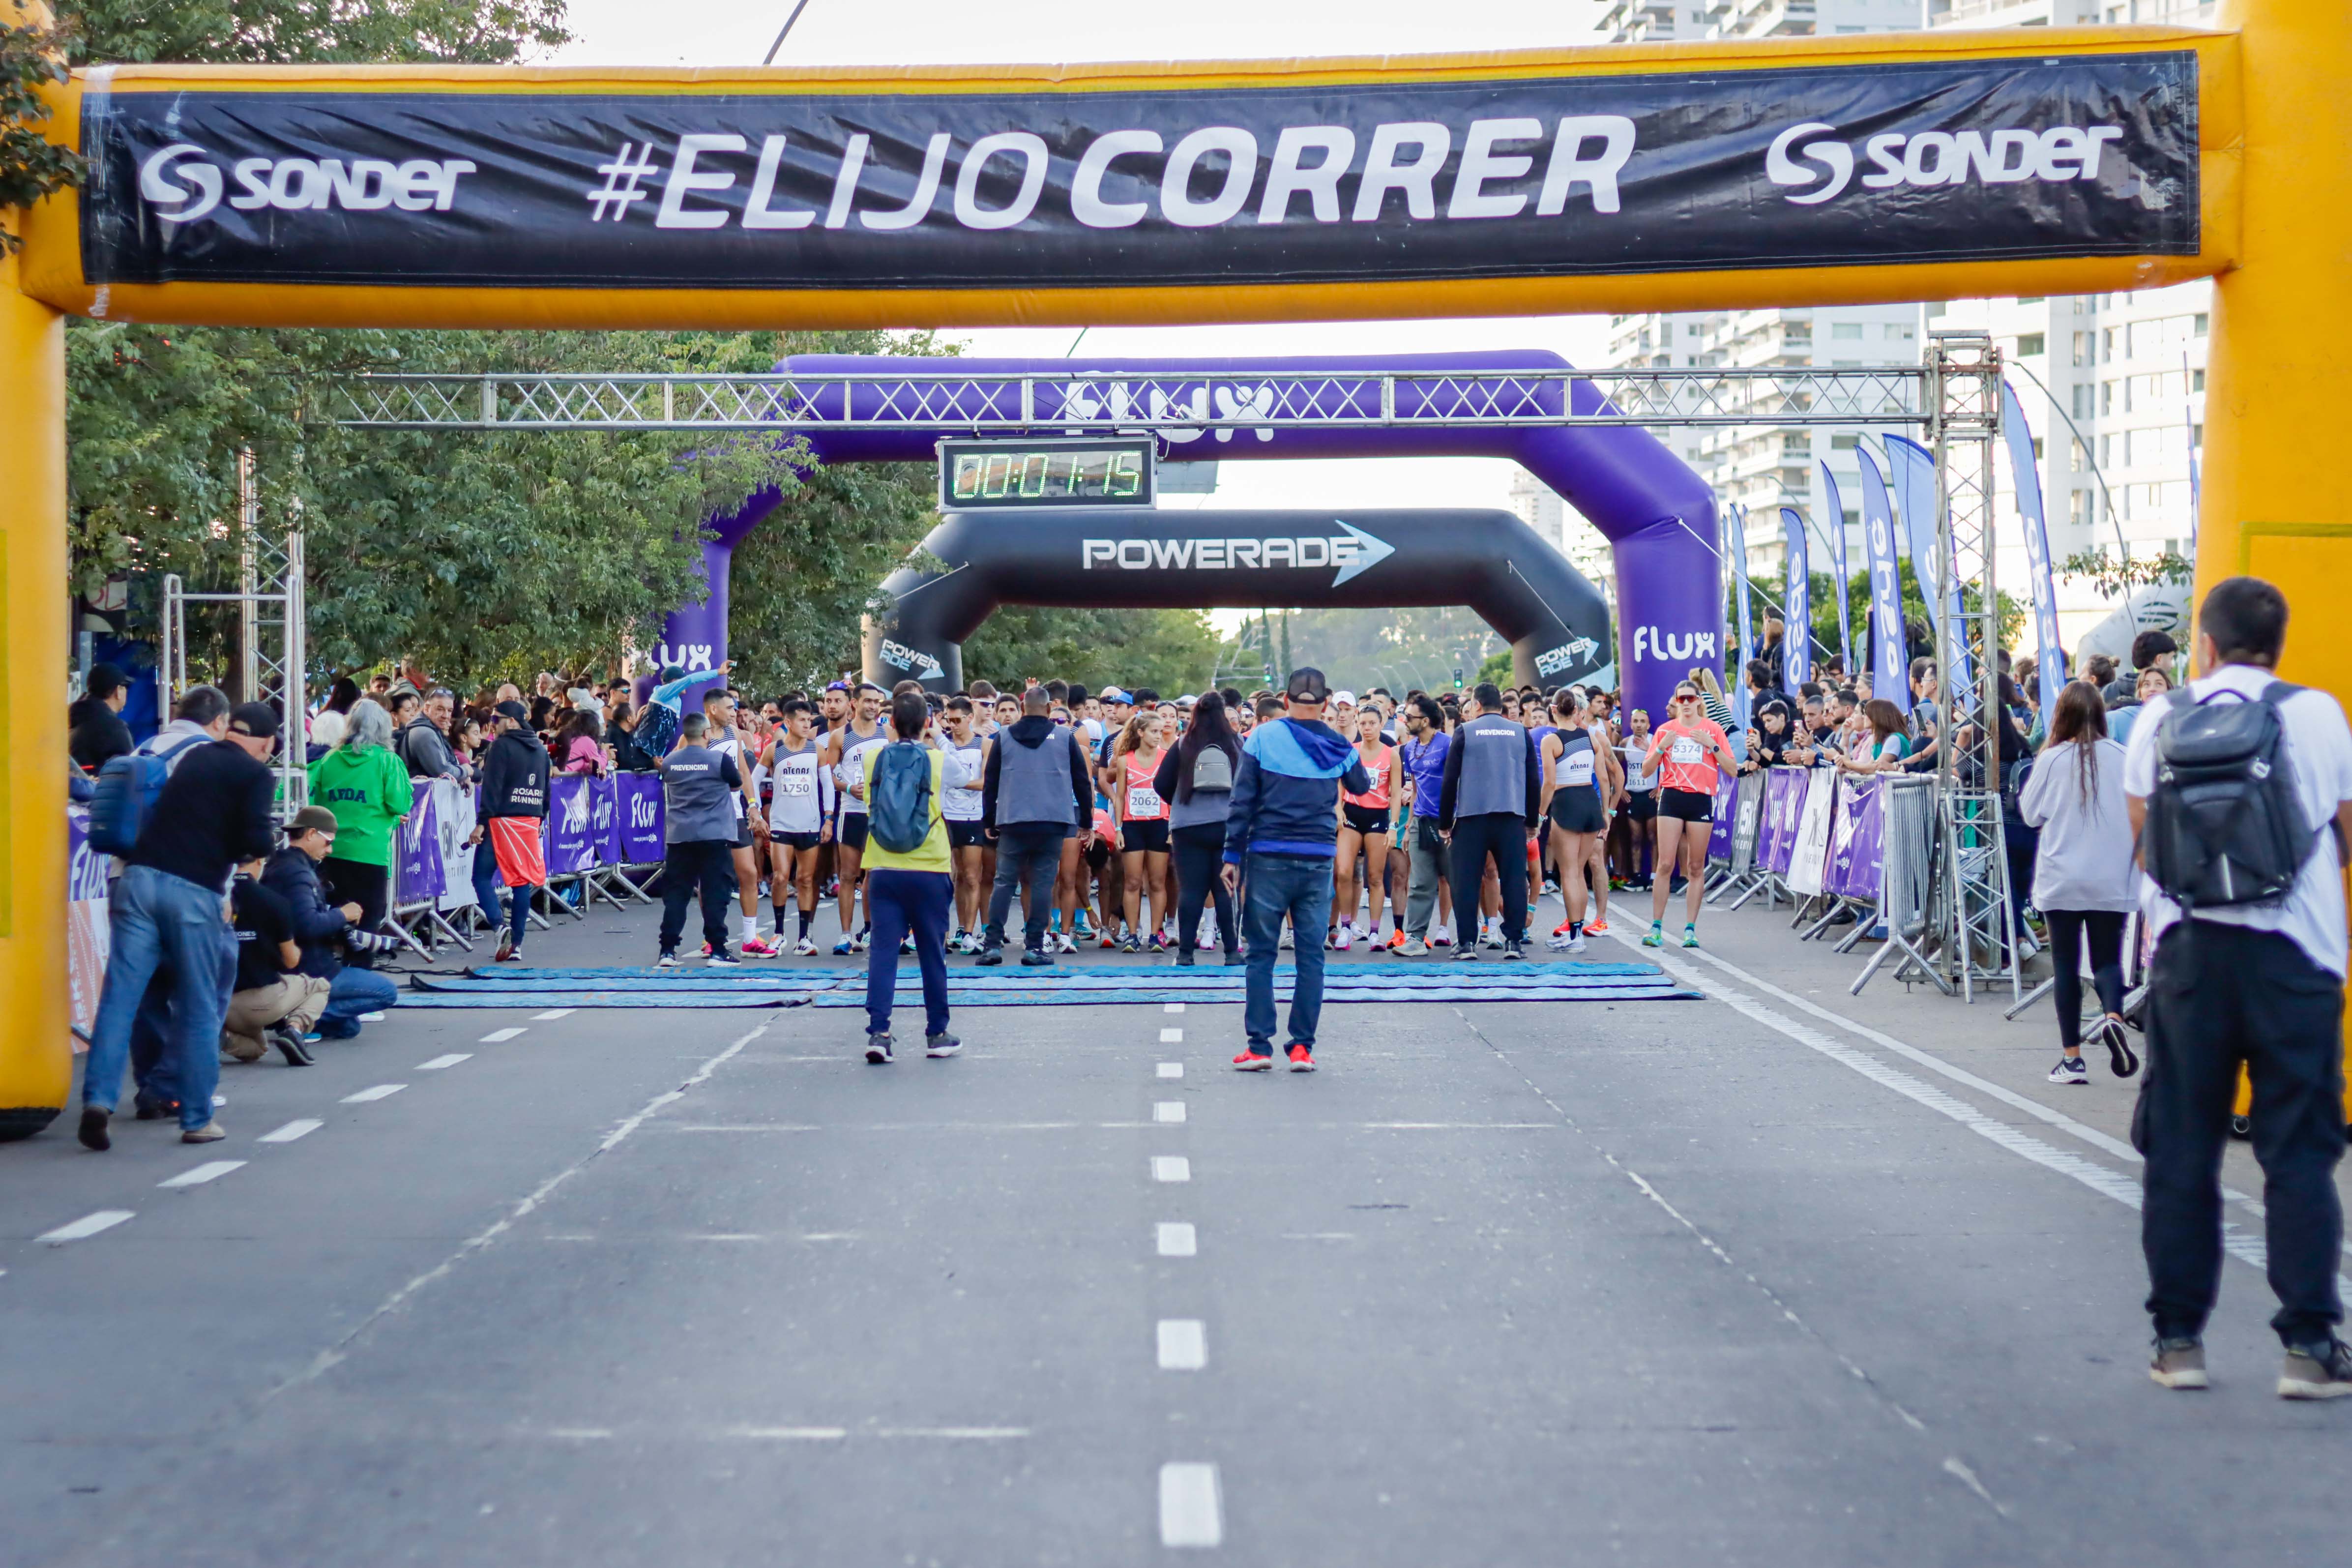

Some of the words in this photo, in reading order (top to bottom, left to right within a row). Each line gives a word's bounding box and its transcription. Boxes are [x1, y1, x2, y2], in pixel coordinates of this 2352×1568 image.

[953, 450, 1141, 499] 00:01:15
[1082, 536, 1360, 570] POWERADE
[879, 649, 912, 671] ADE
[882, 638, 940, 672] POWER
[1534, 637, 1592, 669] POWER
[1539, 655, 1573, 678] ADE
[1475, 729, 1516, 737] PREVENCION
[1673, 745, 1701, 754] 5374
[783, 767, 810, 775] ATENAS
[783, 784, 810, 793] 1750
[1131, 796, 1159, 806] 2062
